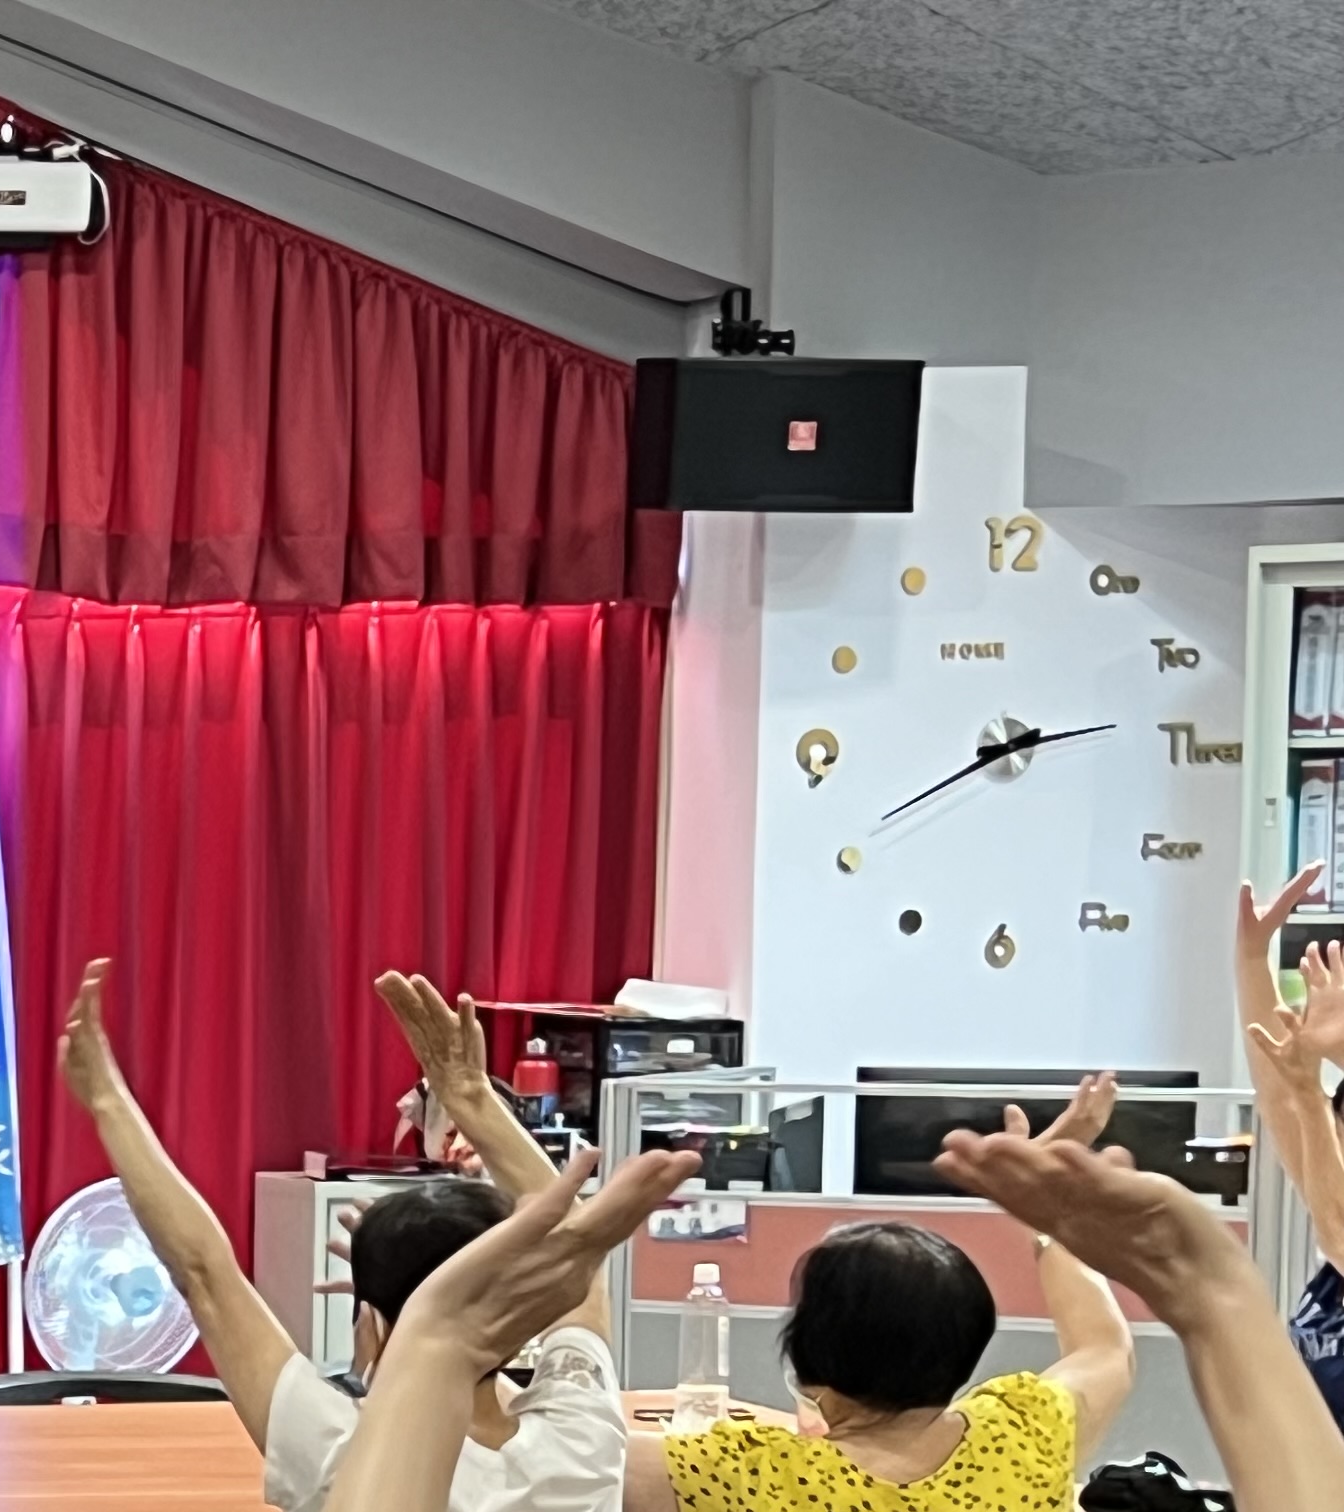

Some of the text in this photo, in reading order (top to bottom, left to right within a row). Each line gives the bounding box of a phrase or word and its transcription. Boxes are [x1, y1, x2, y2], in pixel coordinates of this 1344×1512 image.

[985, 515, 1045, 572] 12
[796, 728, 839, 789] 9
[984, 923, 1016, 968] 6
